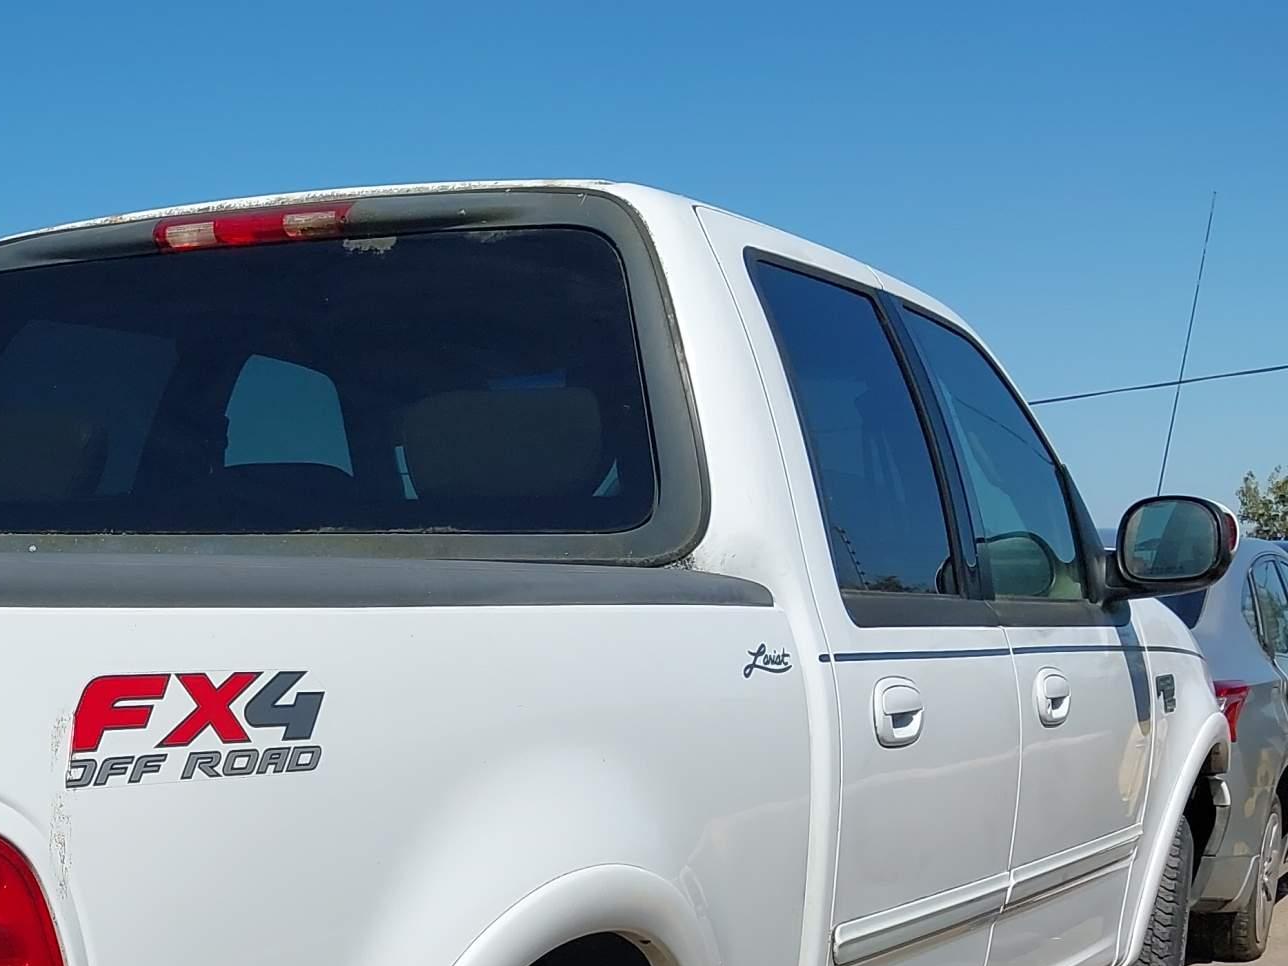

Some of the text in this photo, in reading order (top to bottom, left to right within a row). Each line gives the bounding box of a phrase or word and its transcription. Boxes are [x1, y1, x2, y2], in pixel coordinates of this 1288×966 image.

[743, 643, 793, 679] Lariat
[72, 671, 326, 754] FX4
[65, 745, 323, 789] OFF ROAD
